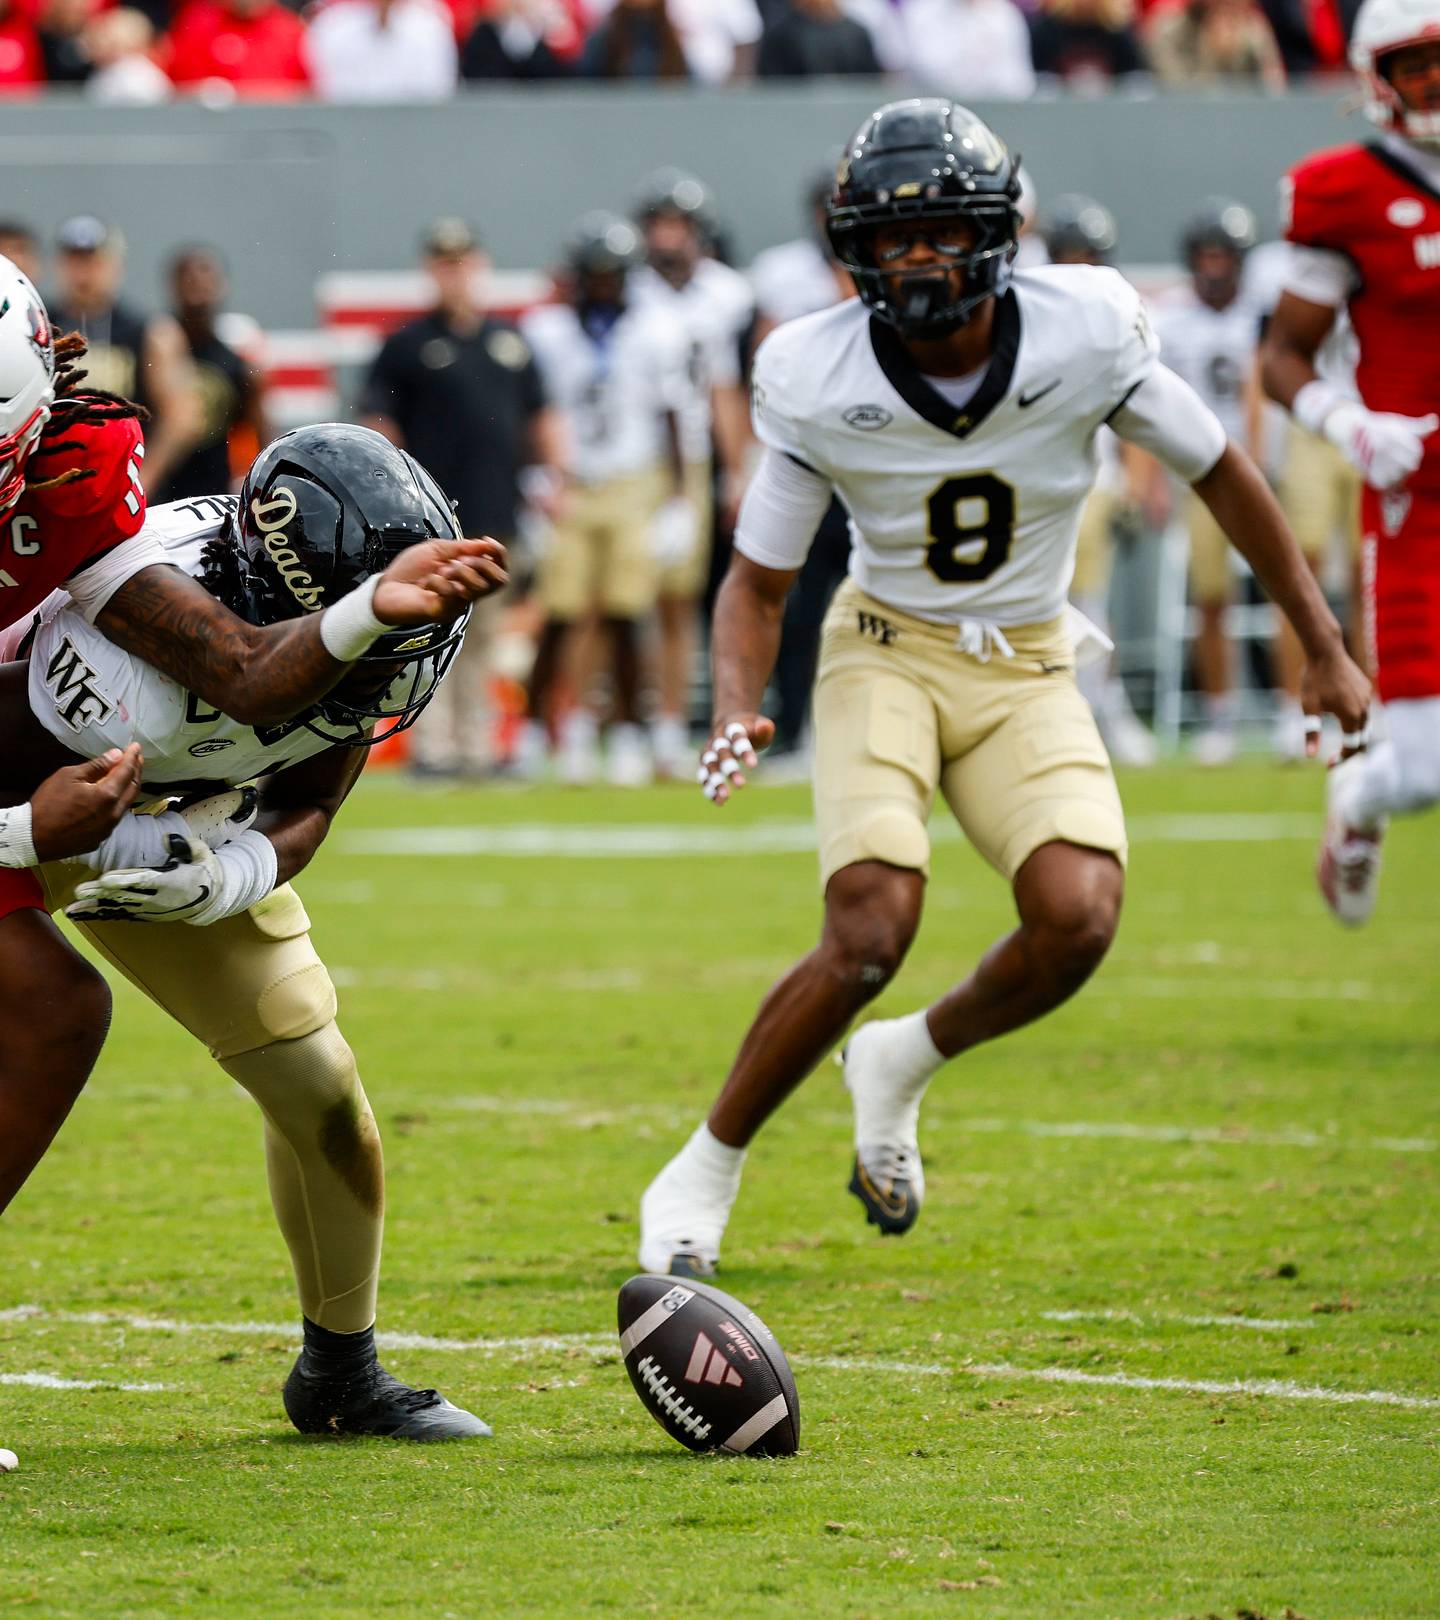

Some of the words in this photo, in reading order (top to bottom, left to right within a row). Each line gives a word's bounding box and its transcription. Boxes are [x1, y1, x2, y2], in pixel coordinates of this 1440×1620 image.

[11, 515, 41, 556] C
[252, 486, 325, 611] Deacs
[925, 473, 1017, 585] 8
[392, 632, 434, 652] ACC
[857, 610, 898, 646] WF
[46, 636, 110, 728] WF
[718, 1320, 760, 1361] DIME
